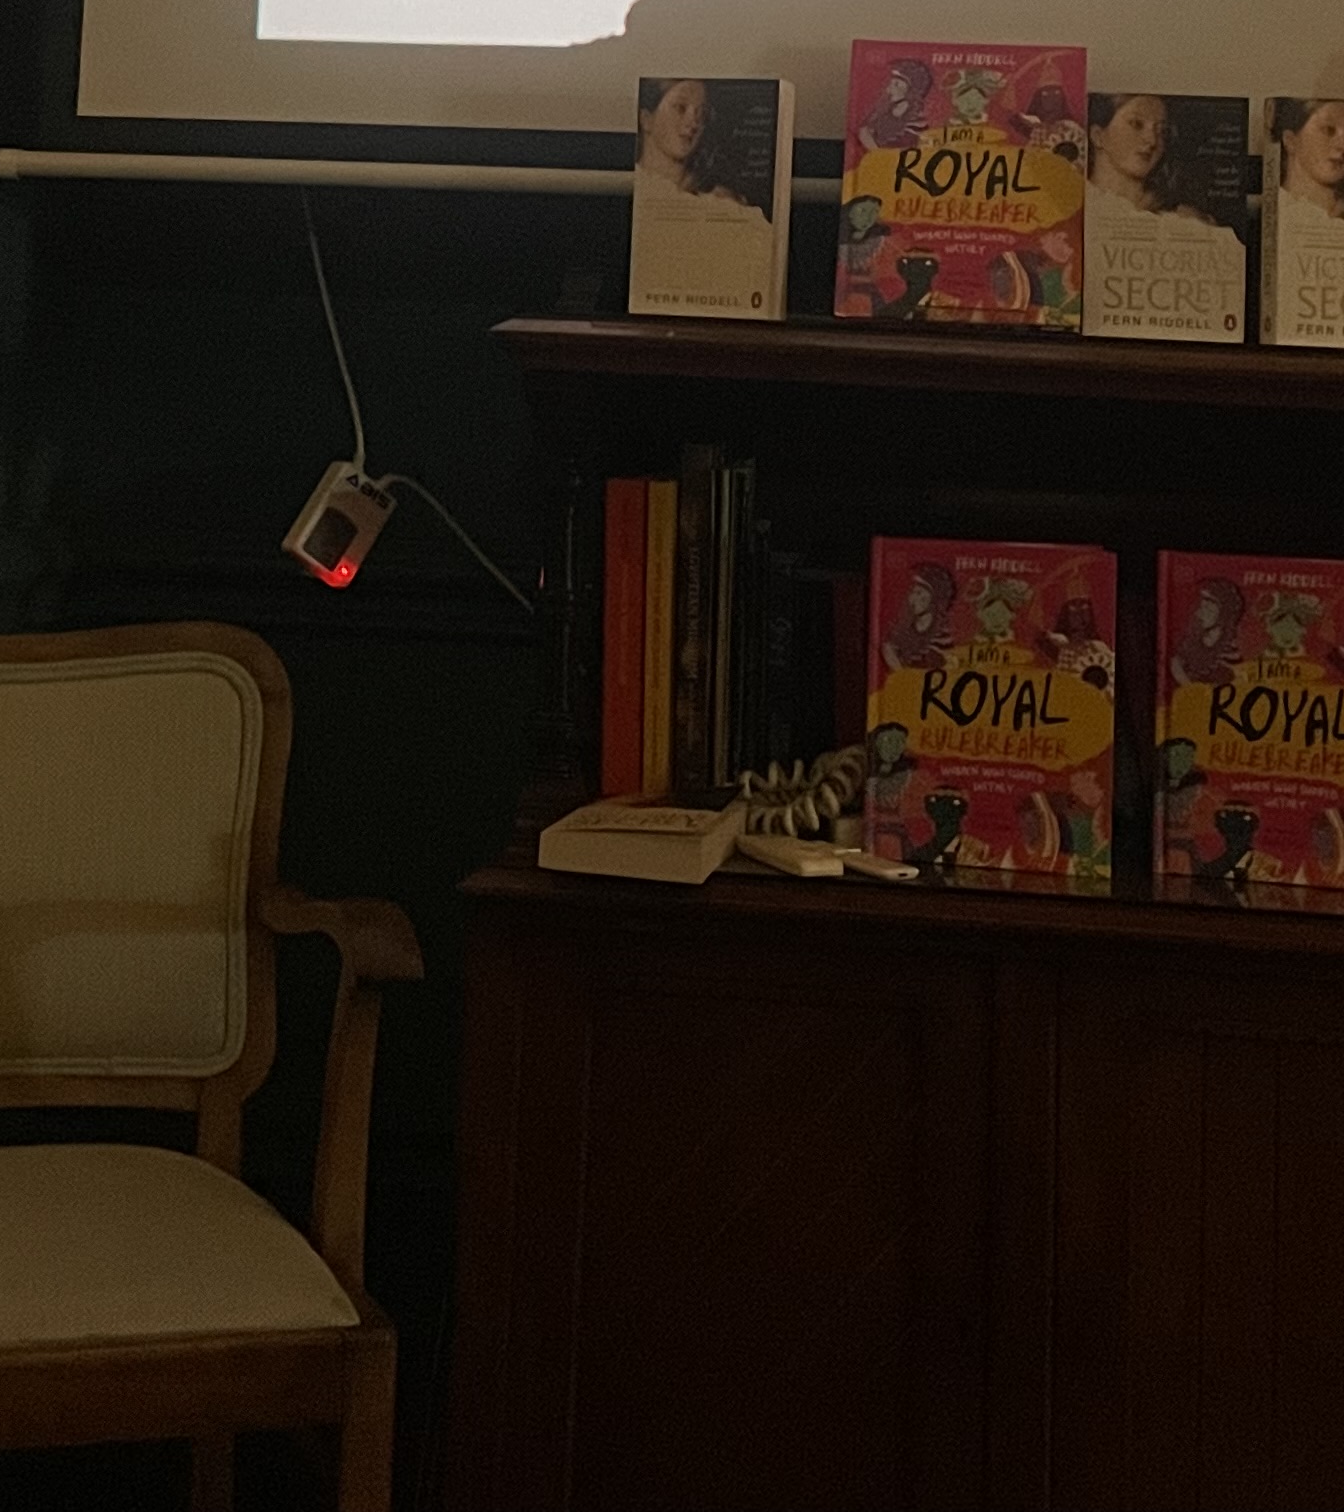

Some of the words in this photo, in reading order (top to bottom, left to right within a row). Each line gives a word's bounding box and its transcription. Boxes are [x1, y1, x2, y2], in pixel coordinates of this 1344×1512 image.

[894, 148, 1040, 200] ROYAL
[895, 195, 1040, 224] RULEBREAKER
[645, 292, 680, 304] FERN
[1103, 275, 1237, 314] SECRET
[1103, 315, 1142, 327] FERN
[1149, 316, 1212, 329] RIDDELL
[1297, 324, 1337, 336] FERN
[920, 668, 1070, 731] ROYAL
[920, 728, 1069, 760] RULEBREAKER
